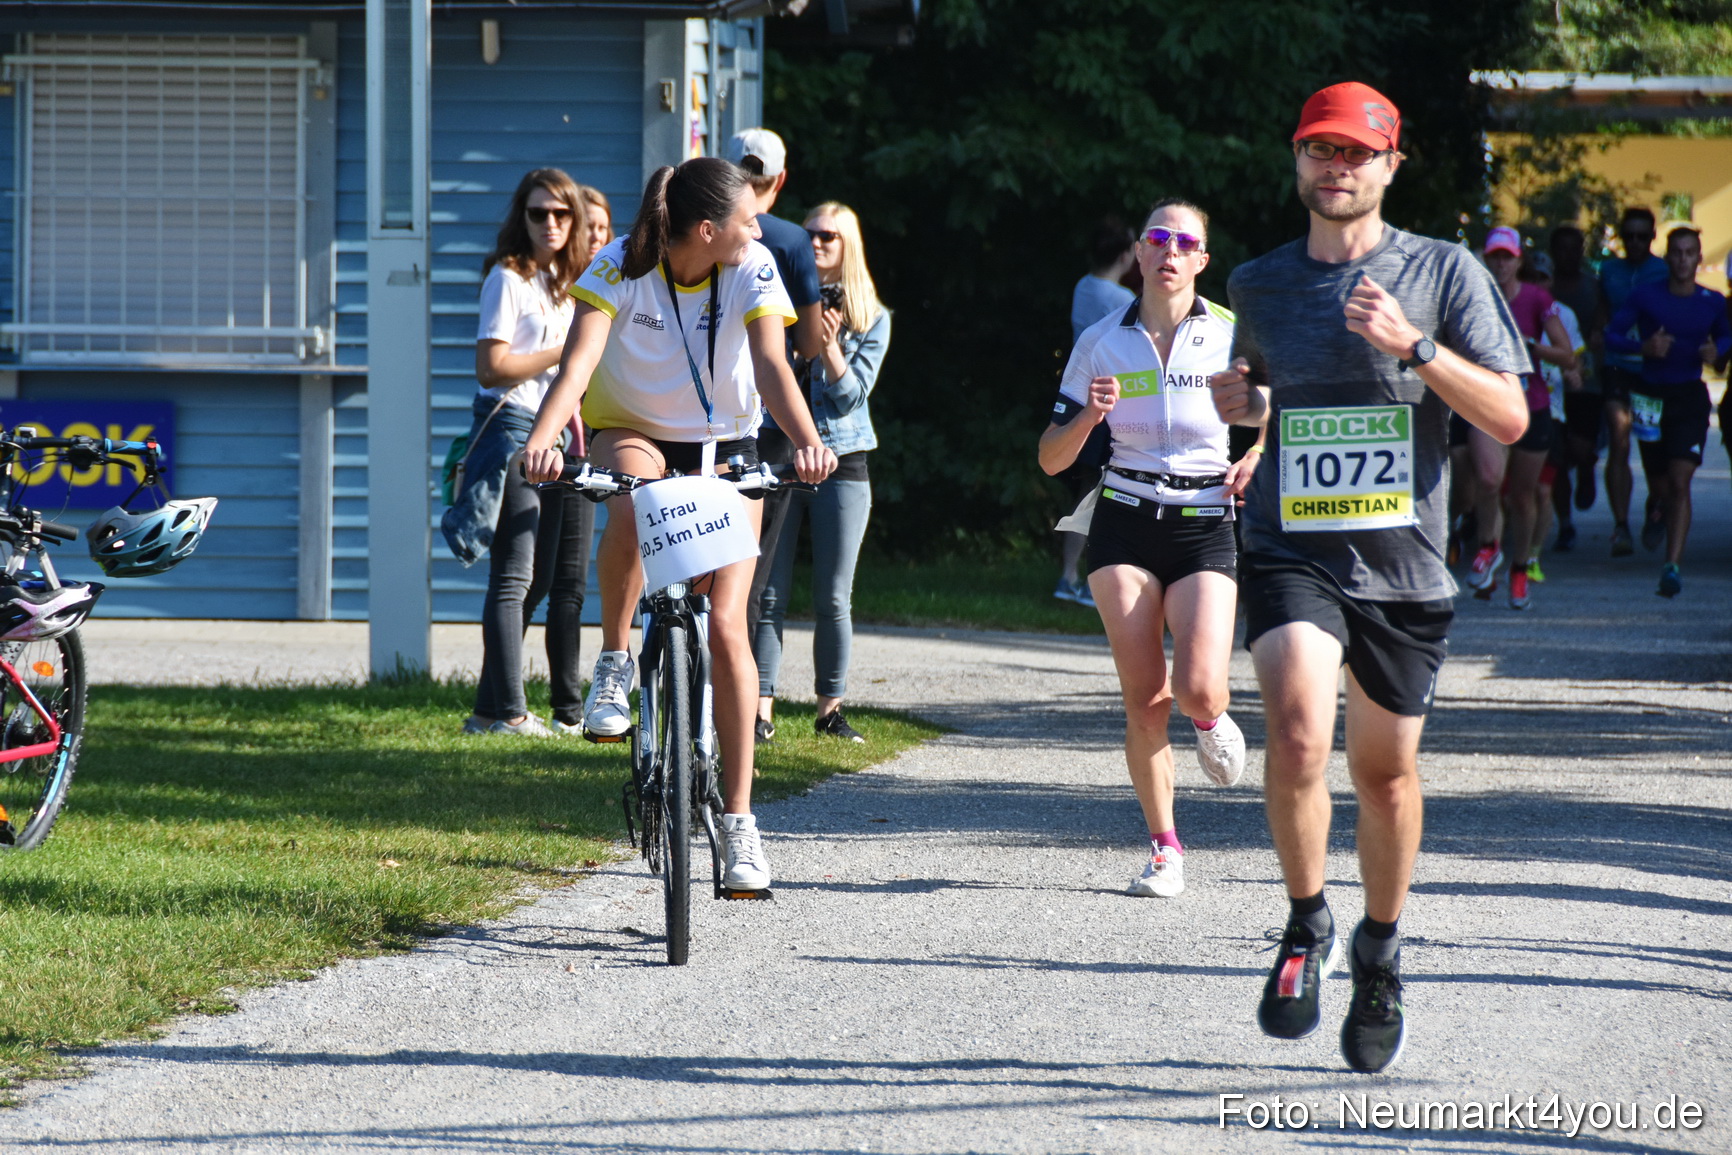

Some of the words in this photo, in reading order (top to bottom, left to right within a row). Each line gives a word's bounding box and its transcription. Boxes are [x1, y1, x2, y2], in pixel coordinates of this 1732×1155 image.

[592, 260, 623, 286] 20
[633, 312, 665, 329] BOCK
[1122, 377, 1149, 393] CIS
[1288, 411, 1401, 443] BOCK
[0, 421, 156, 487] OSK
[1295, 449, 1396, 488] 1072
[1114, 493, 1137, 505] AMBERG
[1291, 497, 1399, 516] CHRISTIAN
[646, 501, 698, 528] 1.Frau
[640, 535, 664, 559] 10,5
[666, 528, 694, 547] km
[695, 512, 732, 537] Lauf
